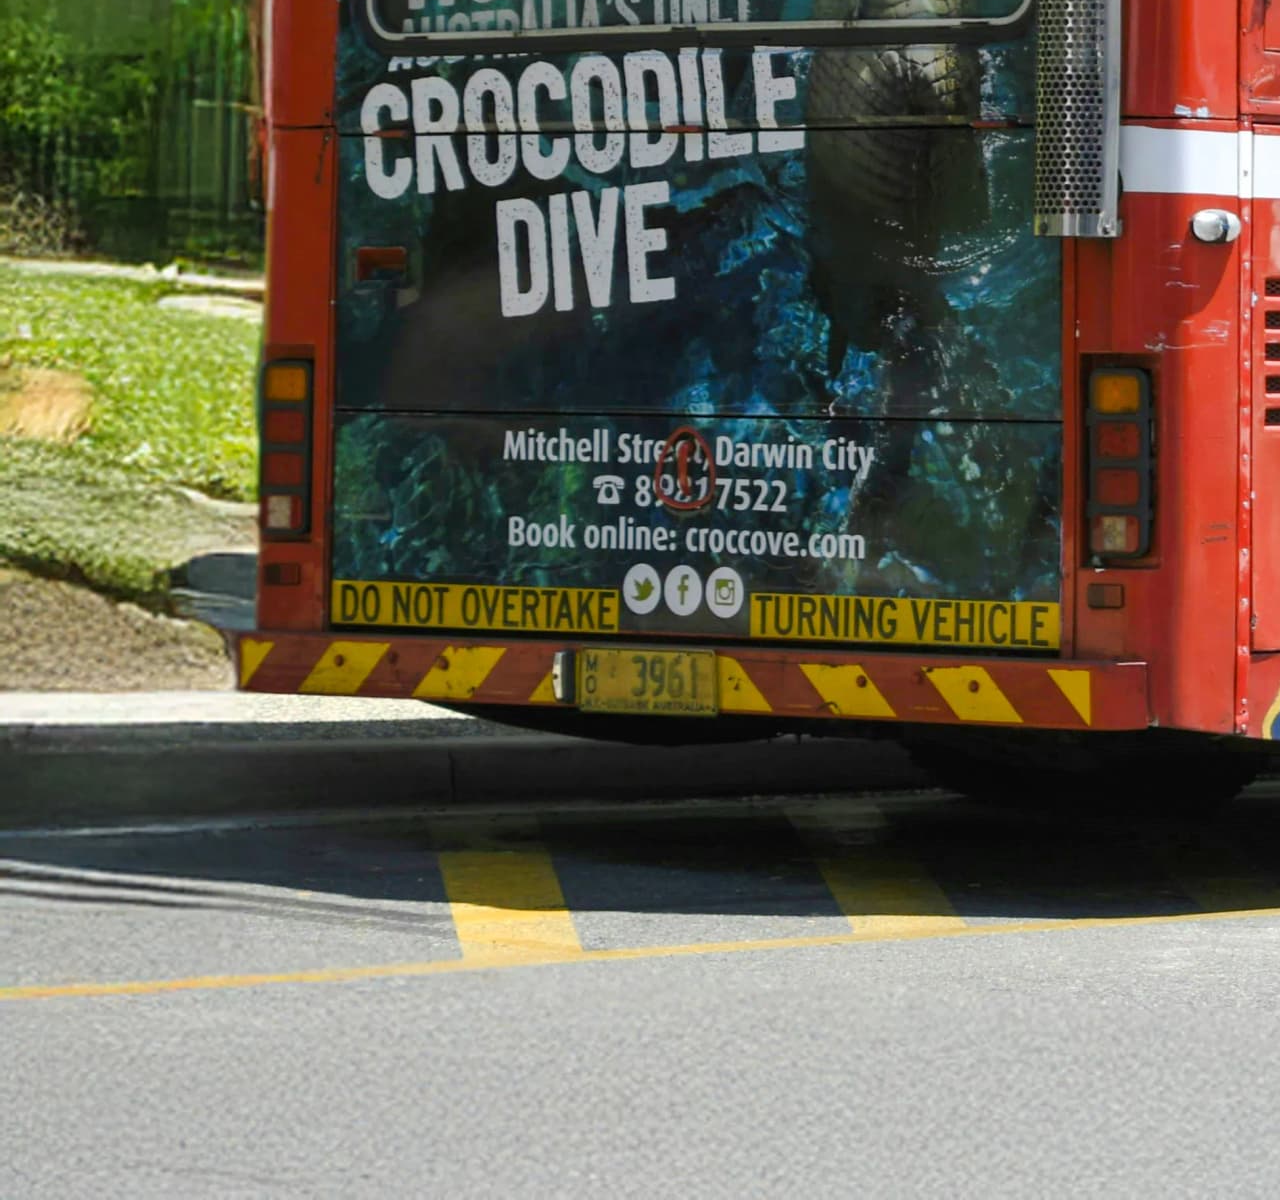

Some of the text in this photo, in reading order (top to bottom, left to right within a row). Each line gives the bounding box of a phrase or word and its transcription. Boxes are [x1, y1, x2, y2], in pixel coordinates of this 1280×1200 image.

[360, 45, 806, 200] CROCODILE
[496, 182, 676, 318] DIVE
[503, 428, 608, 462] Mitchell
[715, 435, 813, 470] Darwin
[818, 437, 874, 479] City
[715, 477, 788, 513] 7522
[508, 515, 865, 559] Book online: croccove.com
[340, 584, 1050, 647] DO NOT OVERTAKE TURNING VEHICLE
[631, 655, 698, 699] 3961
